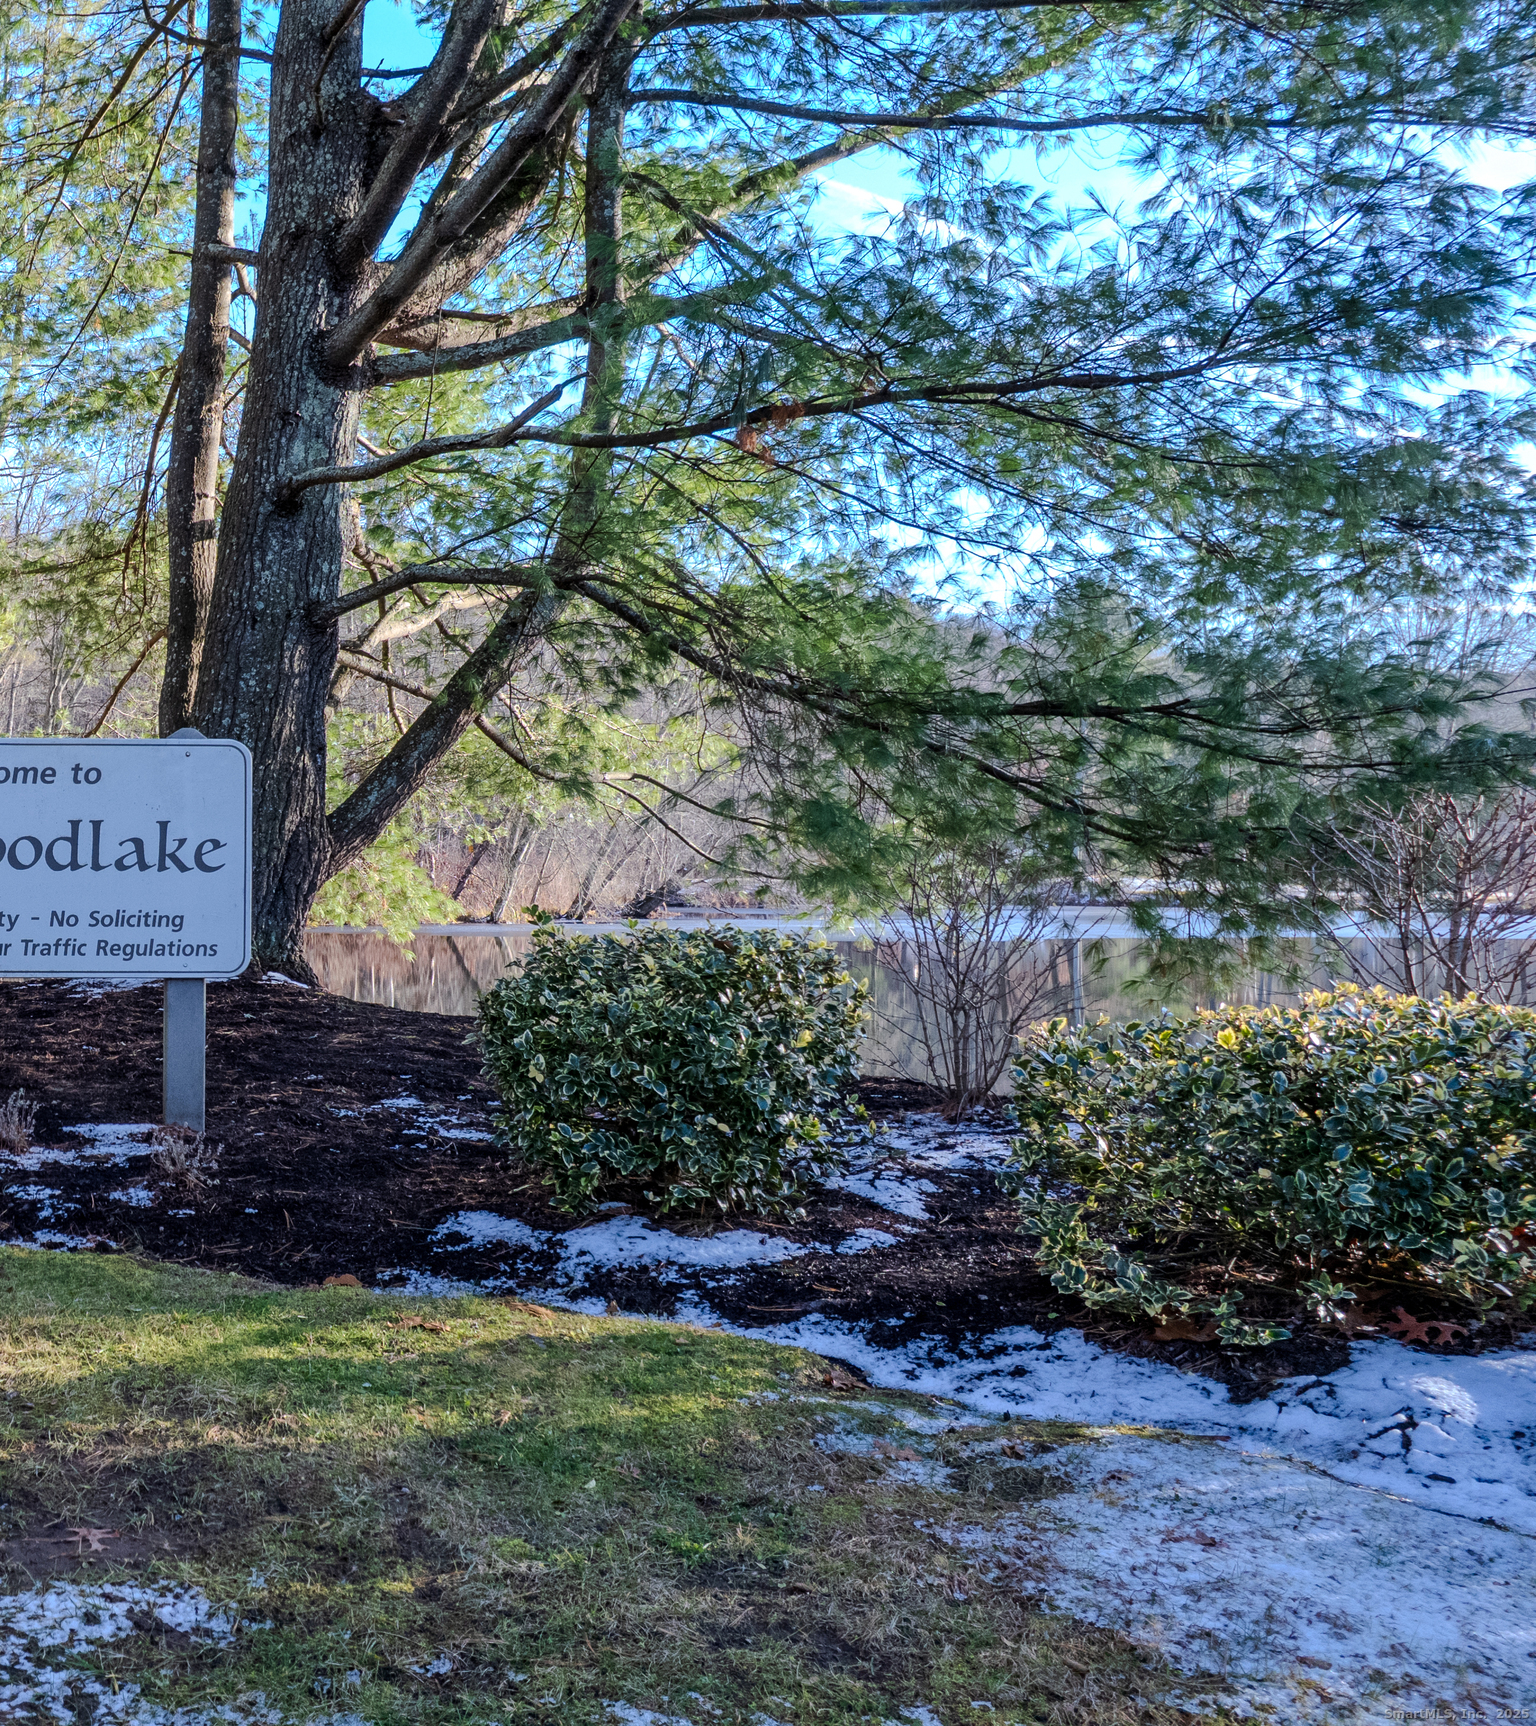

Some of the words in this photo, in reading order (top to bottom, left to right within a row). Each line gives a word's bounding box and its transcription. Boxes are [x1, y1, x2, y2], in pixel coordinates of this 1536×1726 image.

[70, 762, 103, 785] to
[49, 910, 80, 928] No
[88, 908, 185, 933] Soliciting
[20, 937, 88, 957] Traffic
[95, 938, 218, 962] Regulations
